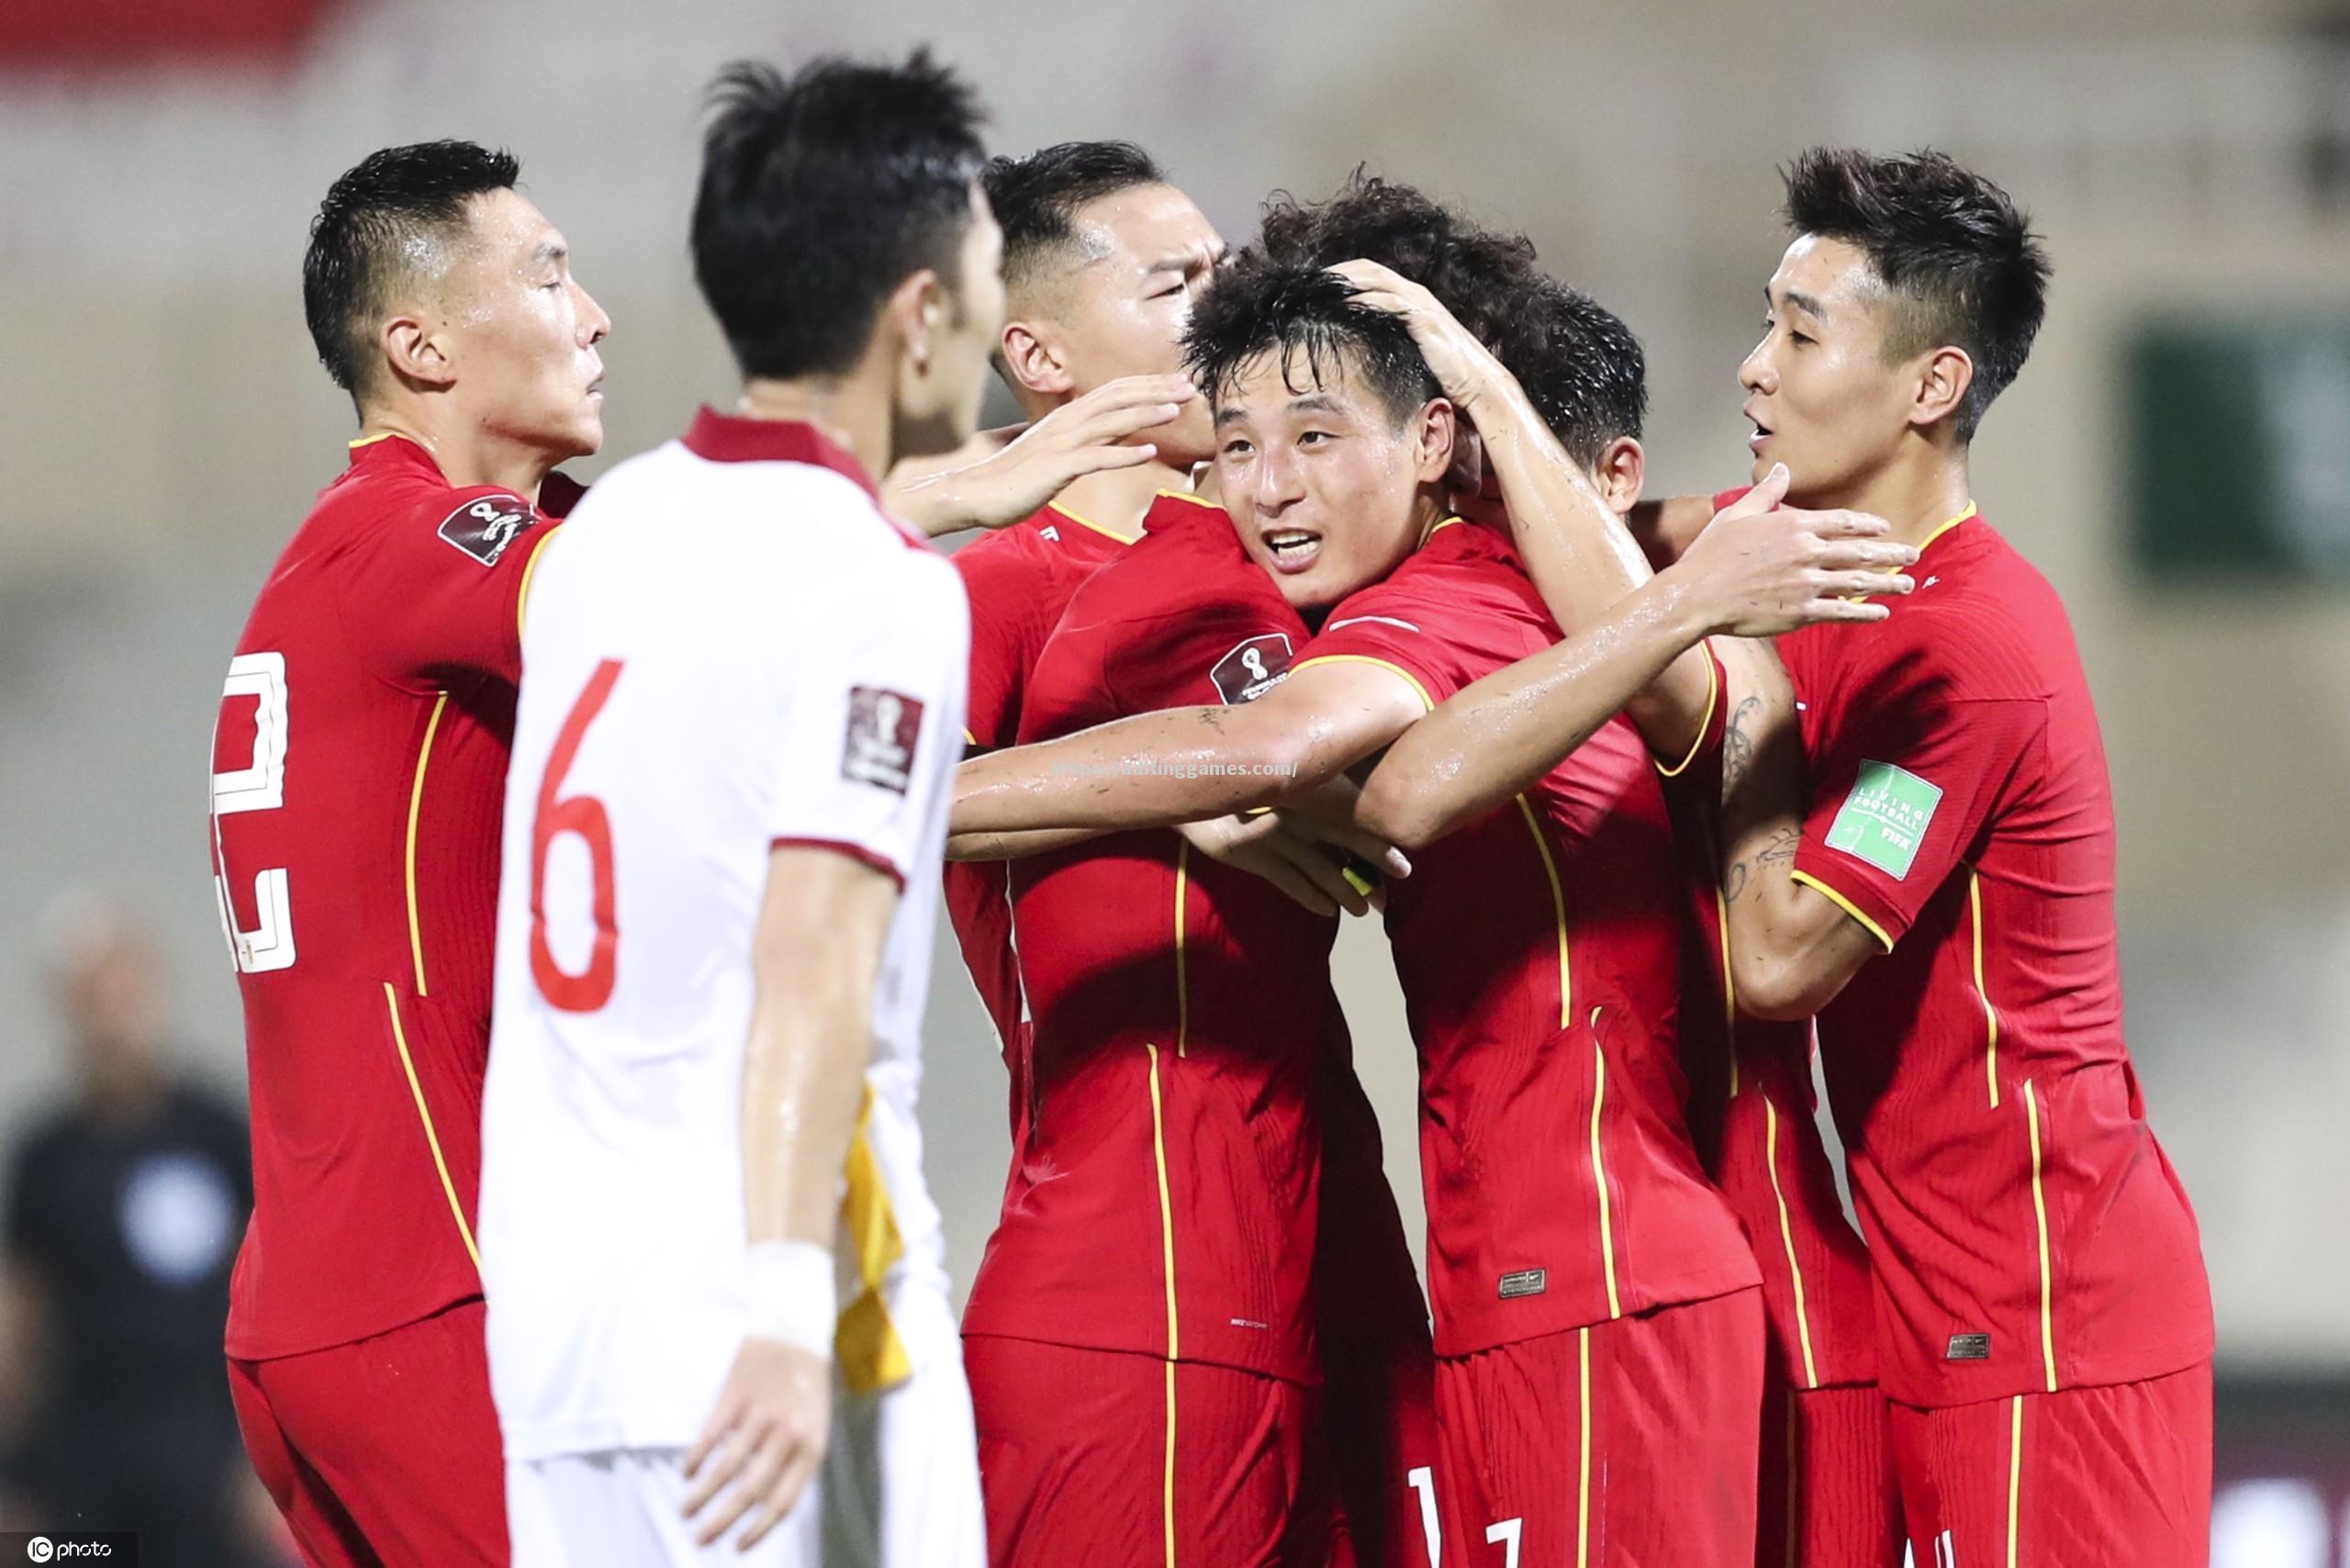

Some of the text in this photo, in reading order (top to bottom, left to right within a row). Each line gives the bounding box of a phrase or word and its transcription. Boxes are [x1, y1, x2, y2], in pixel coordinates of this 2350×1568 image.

[1853, 795, 1918, 831] FOOTBALL
[1859, 787, 1924, 822] LIVING
[529, 659, 625, 1014] 6
[1881, 827, 1913, 852] FIFA
